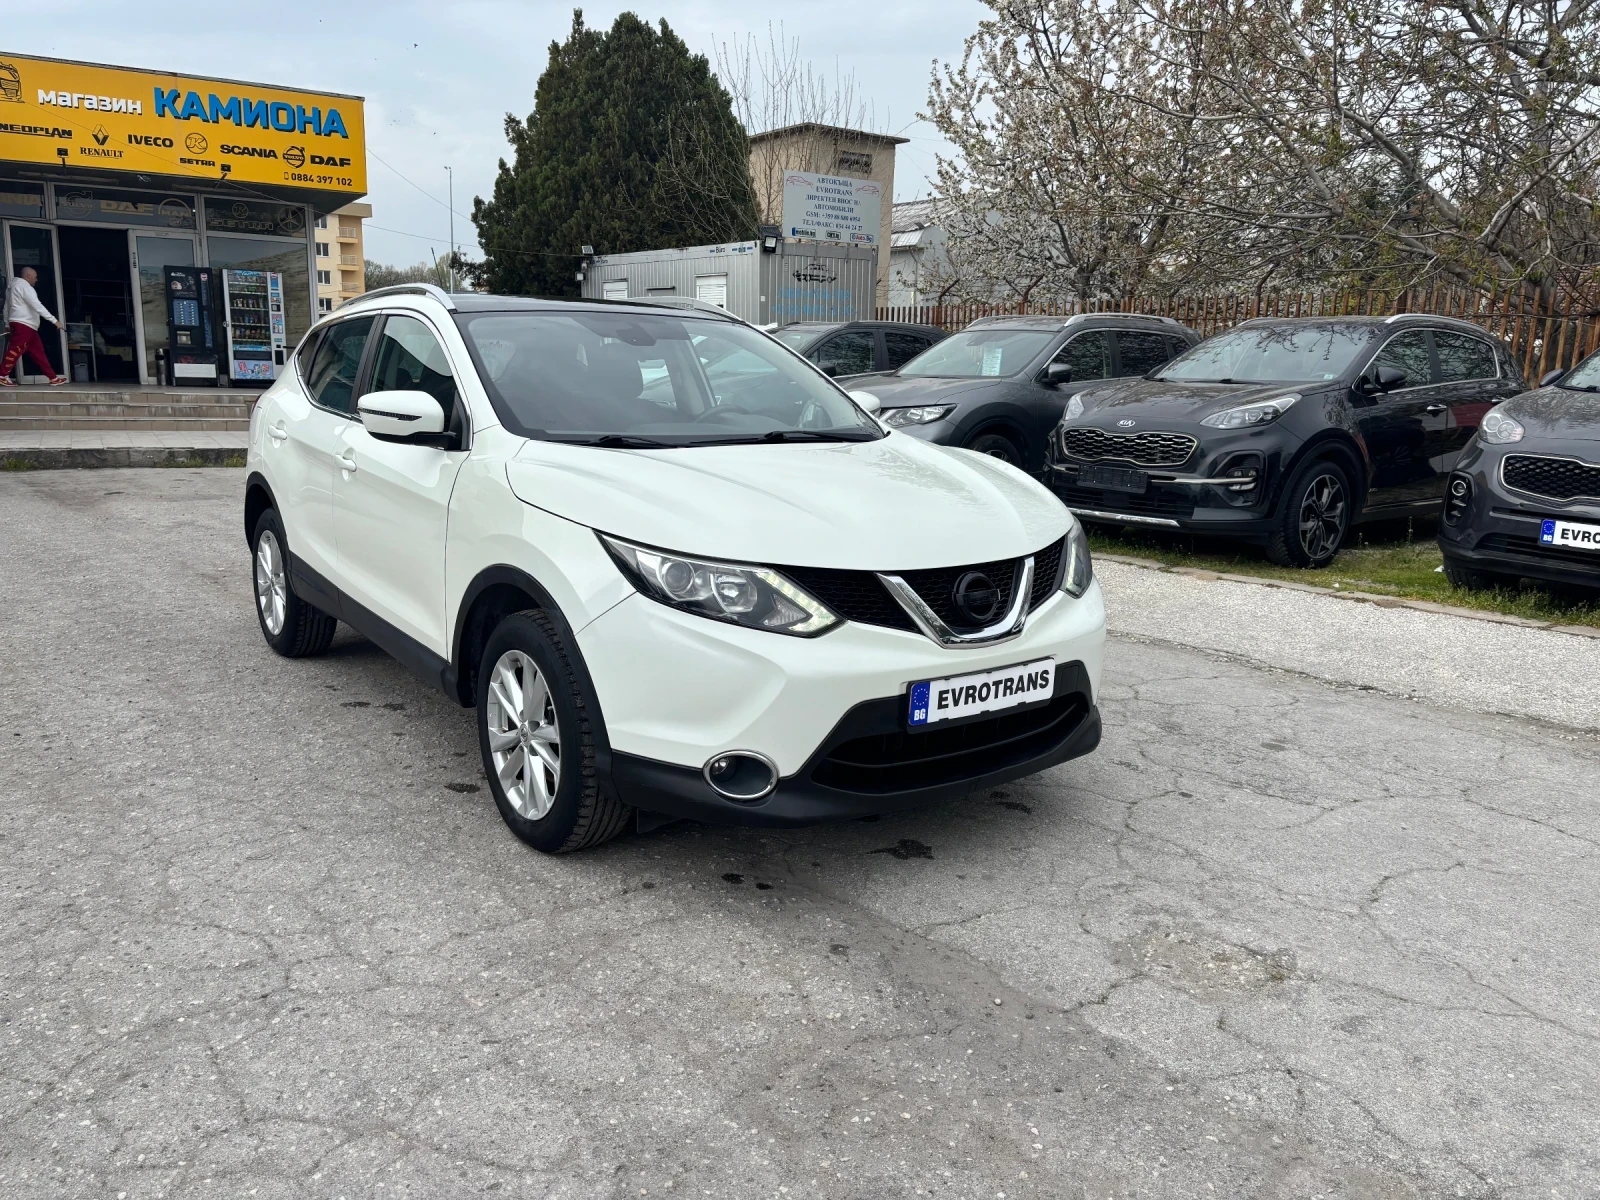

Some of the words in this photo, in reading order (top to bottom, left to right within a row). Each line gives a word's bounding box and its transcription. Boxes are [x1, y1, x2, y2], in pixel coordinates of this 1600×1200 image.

[37, 88, 142, 115] магазин
[153, 87, 349, 139] КАМИОНА
[0, 122, 73, 139] NEOPLAN
[128, 134, 174, 148] IVECO
[80, 147, 124, 158] RENAULT
[220, 144, 279, 160] SCANIA
[283, 153, 305, 161] VOLVO
[179, 157, 216, 167] SETRA
[310, 154, 351, 168] DAF
[291, 172, 314, 183] 0884
[316, 175, 334, 185] 397
[335, 177, 353, 187] 102
[816, 177, 853, 188] АВТОКЪЩА
[815, 185, 853, 196] EVROTRANS
[805, 194, 836, 203] ДИРЕКТЕН
[837, 196, 853, 205] ВНОС
[100, 200, 153, 213] DAF
[814, 203, 854, 213] АВТОМОБИЛИ
[161, 209, 189, 217] MAN
[805, 210, 821, 218] GSM:
[209, 217, 274, 231] SETRA
[1118, 419, 1134, 427] KIA
[1542, 534, 1553, 542] BG
[913, 708, 926, 721] BG
[937, 669, 1050, 711] EVROTRANS
